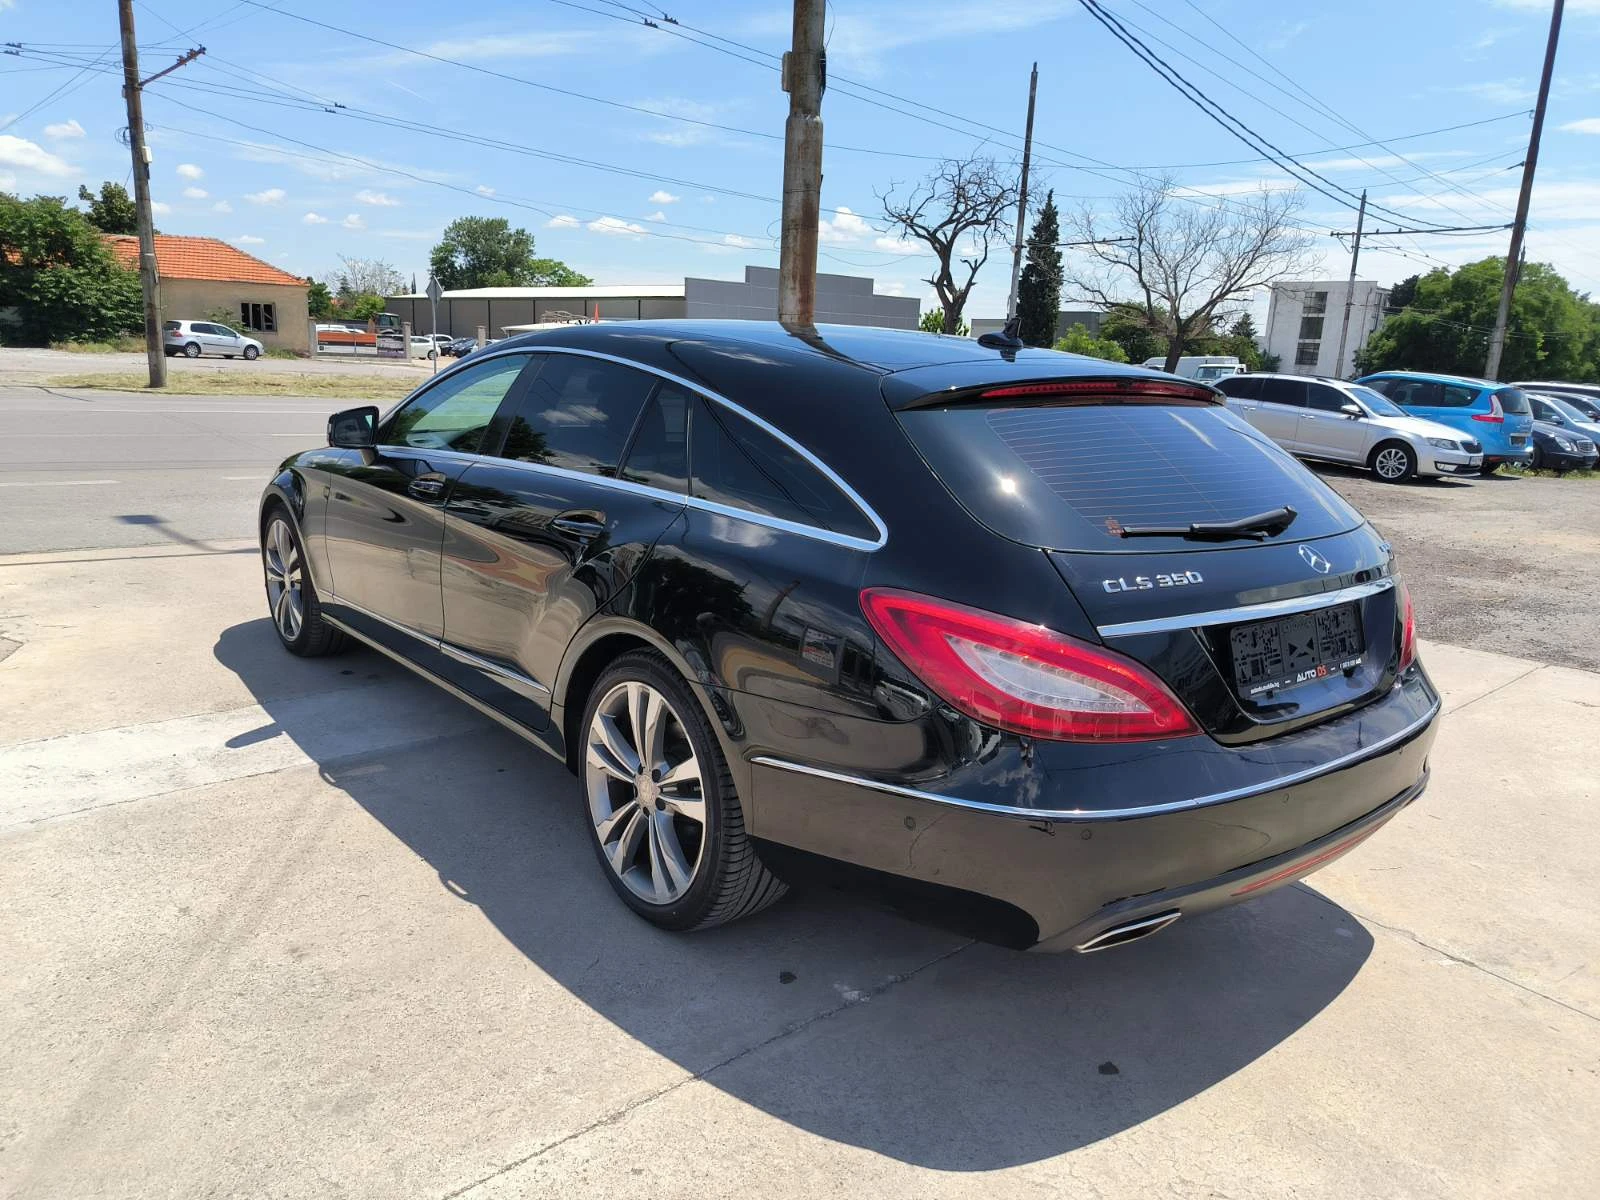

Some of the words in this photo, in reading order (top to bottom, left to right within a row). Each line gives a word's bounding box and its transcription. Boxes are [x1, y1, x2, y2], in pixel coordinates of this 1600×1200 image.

[1102, 576, 1153, 593] CLS
[1156, 571, 1203, 587] 350
[1296, 670, 1316, 682] AUTO
